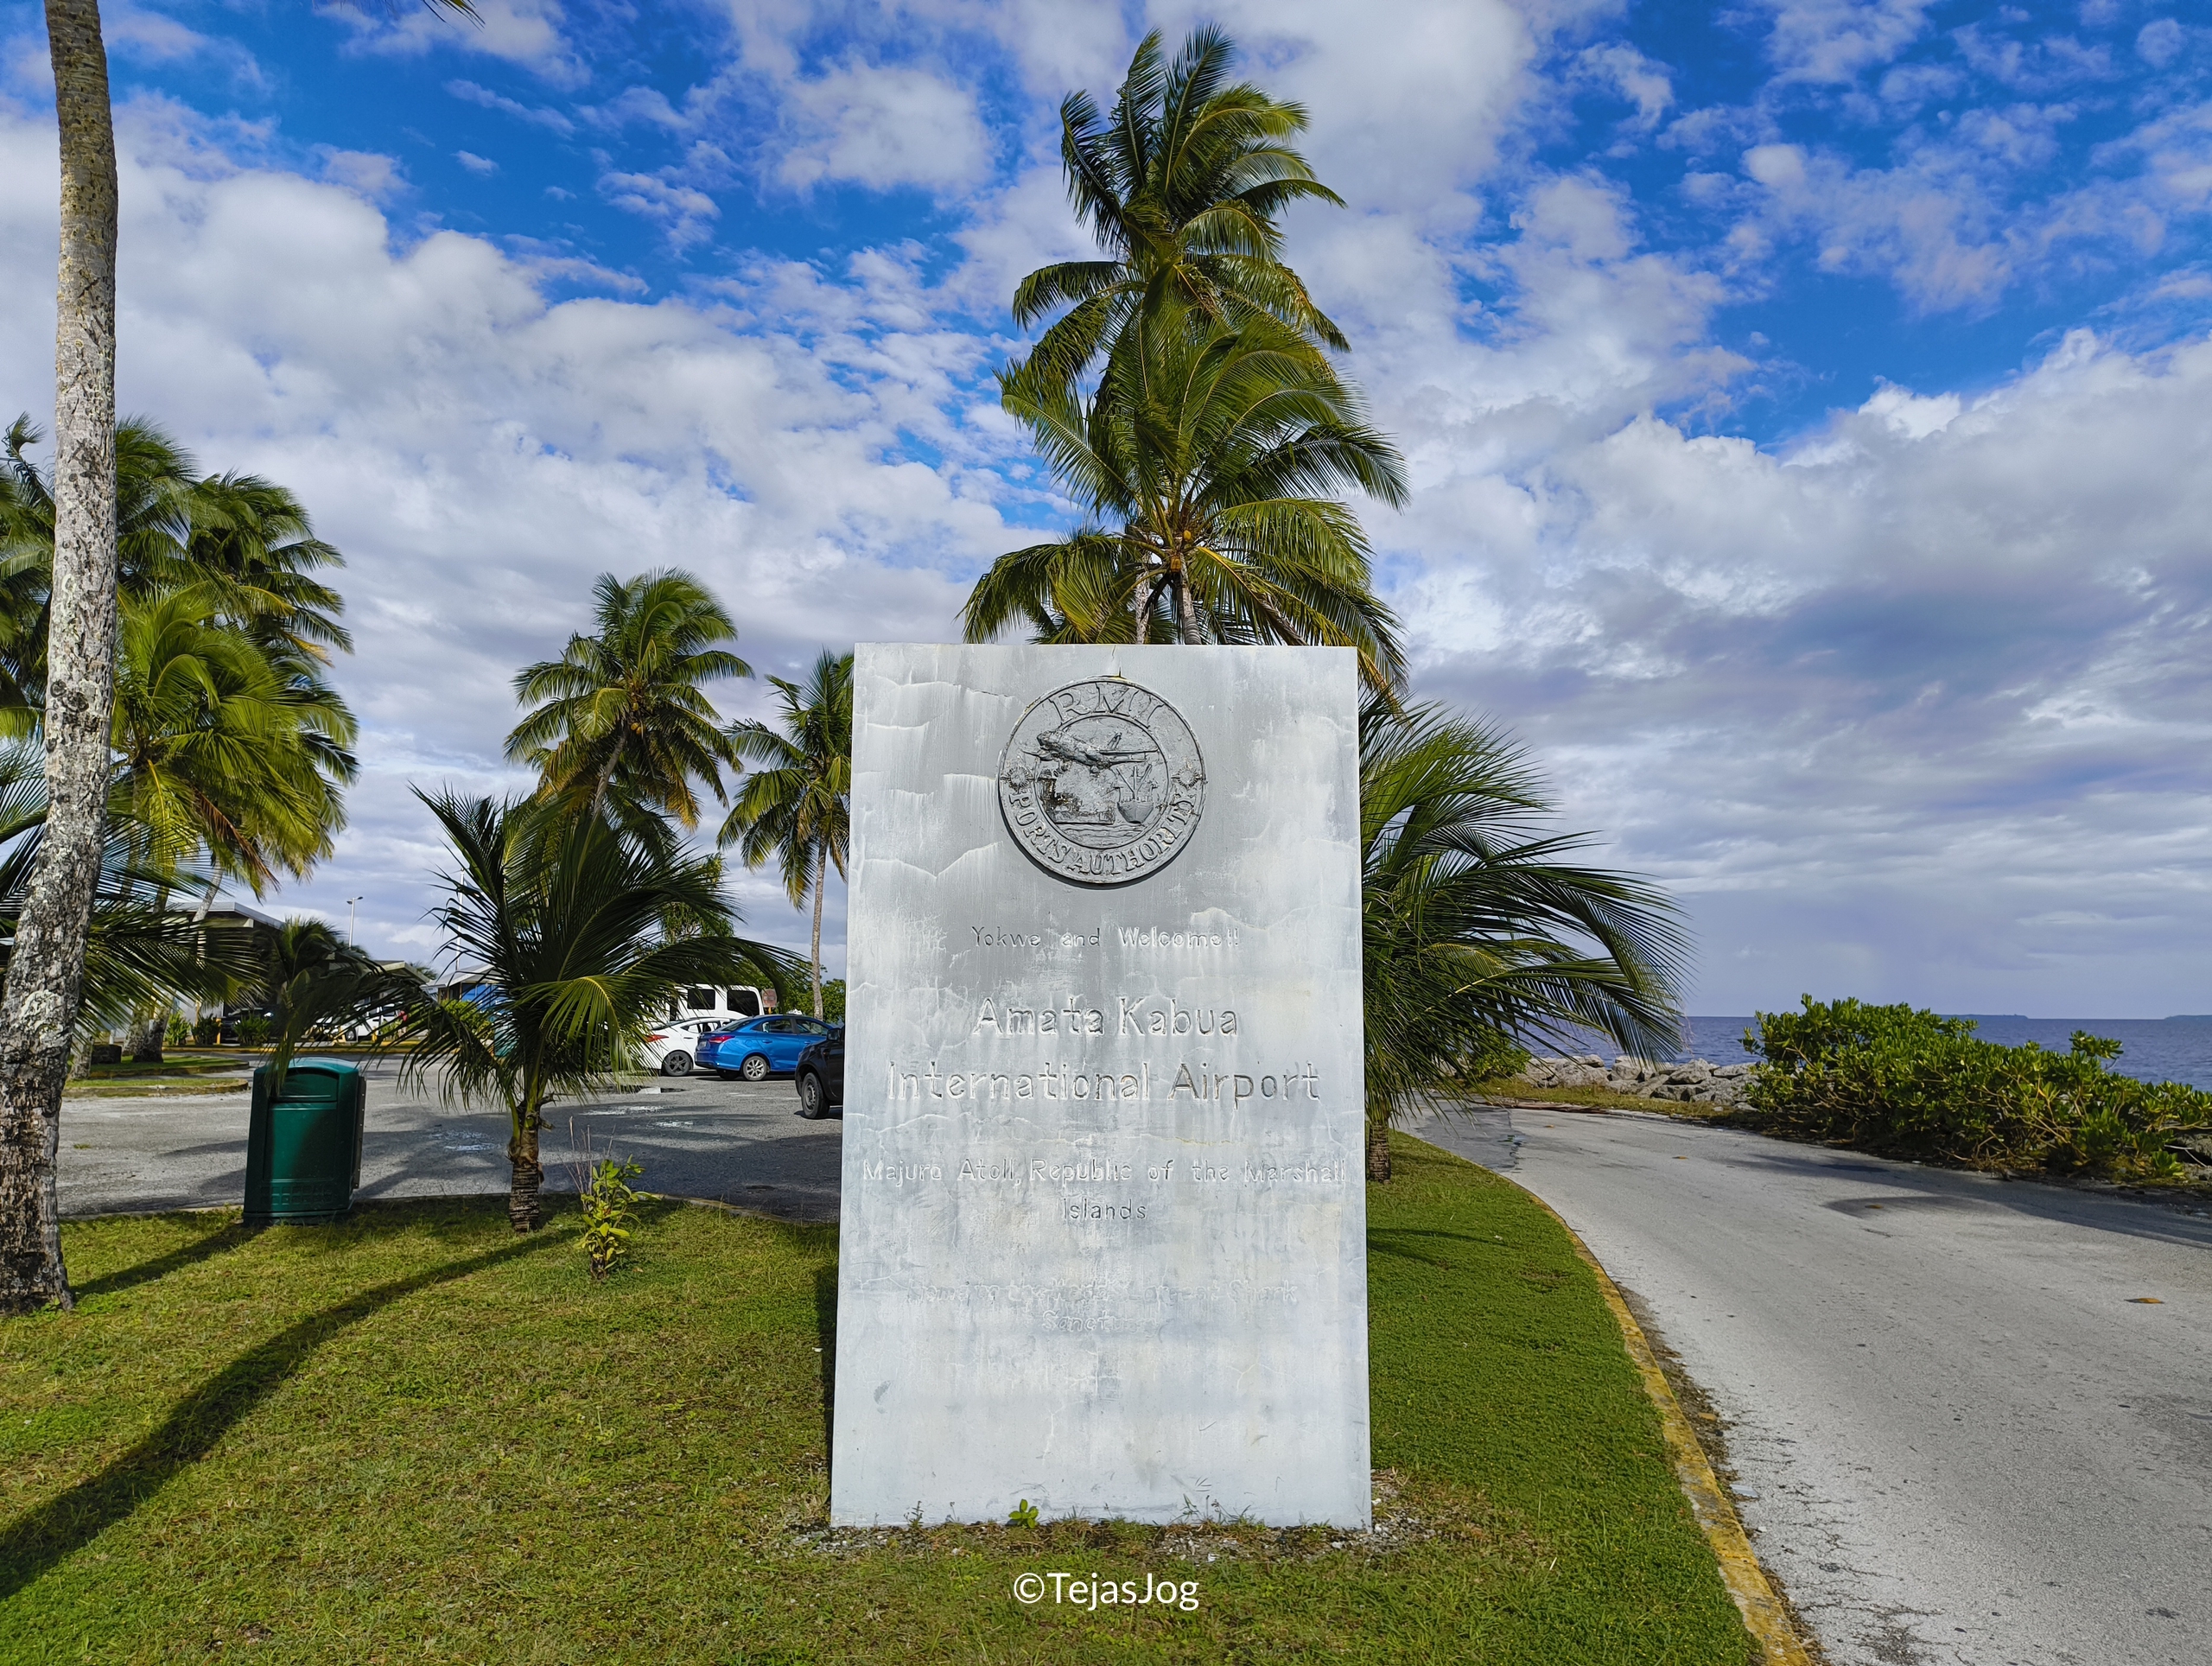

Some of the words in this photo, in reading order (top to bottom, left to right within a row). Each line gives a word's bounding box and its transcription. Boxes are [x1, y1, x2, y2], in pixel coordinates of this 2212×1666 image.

[1049, 682, 1165, 728] RMI
[1007, 791, 1070, 863] PORTS
[1067, 787, 1198, 875] AUTHORITY
[970, 925, 1042, 949] Yokwe
[1061, 927, 1102, 949] and
[1117, 925, 1240, 949] Welcome!!
[972, 996, 1106, 1037] Amata
[1118, 996, 1239, 1037] Kabua
[887, 1060, 1151, 1102] International
[1167, 1061, 1321, 1110] Airport
[862, 1158, 942, 1187] Majuro
[957, 1158, 1022, 1186] Atoll,
[1029, 1158, 1132, 1187] Republic
[1147, 1159, 1174, 1181] of
[1192, 1158, 1231, 1182] the
[1243, 1159, 1347, 1183] Marshall
[1062, 1197, 1147, 1220] Islands
